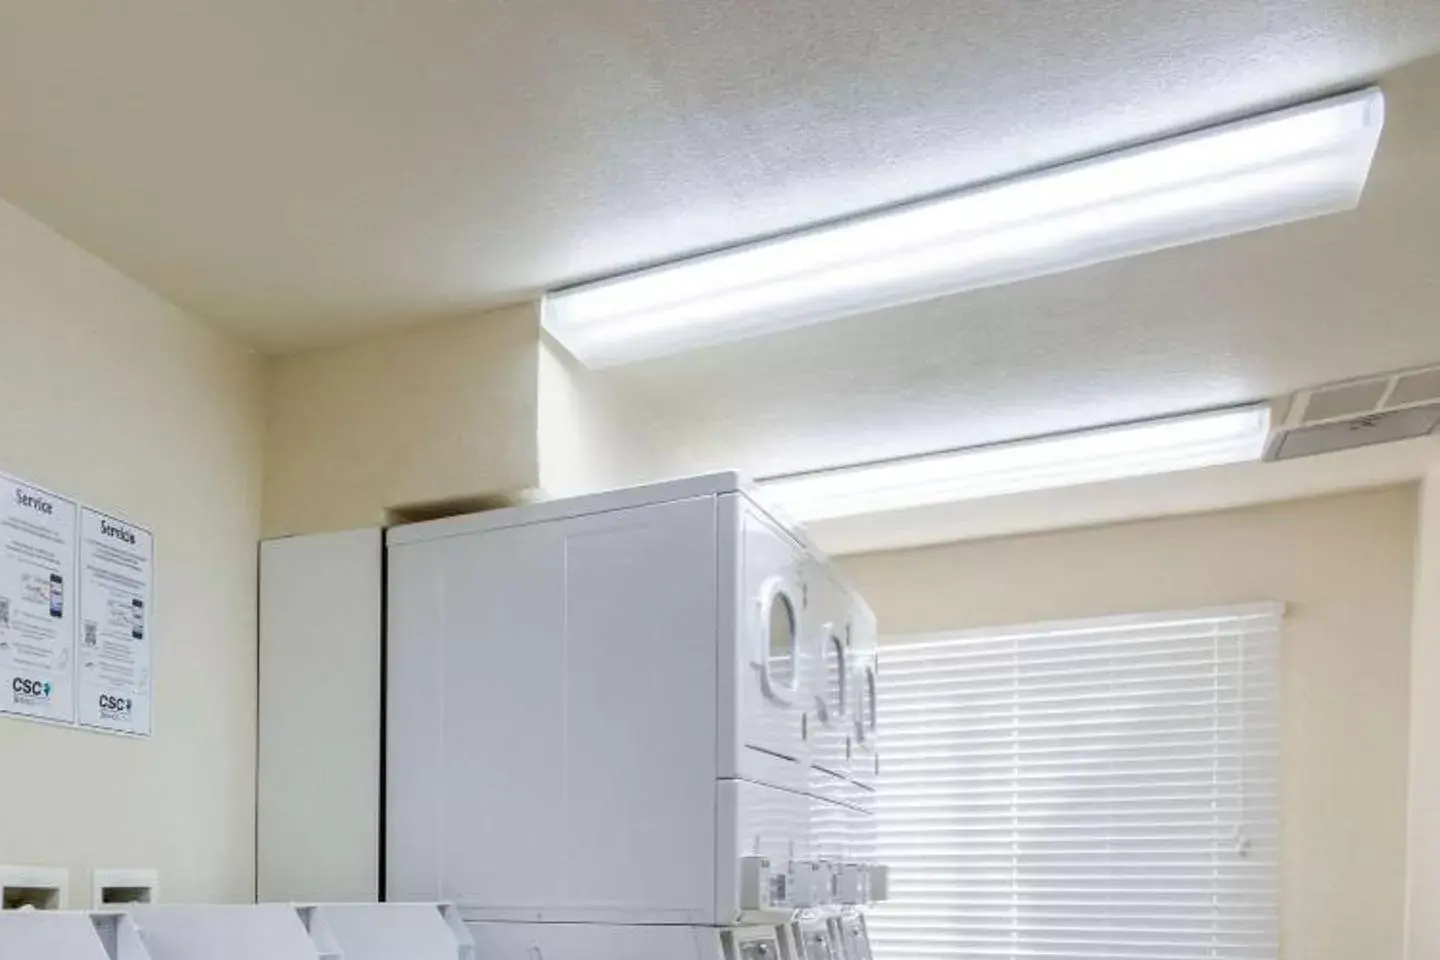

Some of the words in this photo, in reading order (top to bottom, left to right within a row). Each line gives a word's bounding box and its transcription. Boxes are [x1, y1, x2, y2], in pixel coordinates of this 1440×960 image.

[16, 488, 53, 515] Service
[12, 677, 42, 695] CSC
[99, 694, 125, 711] CSC
